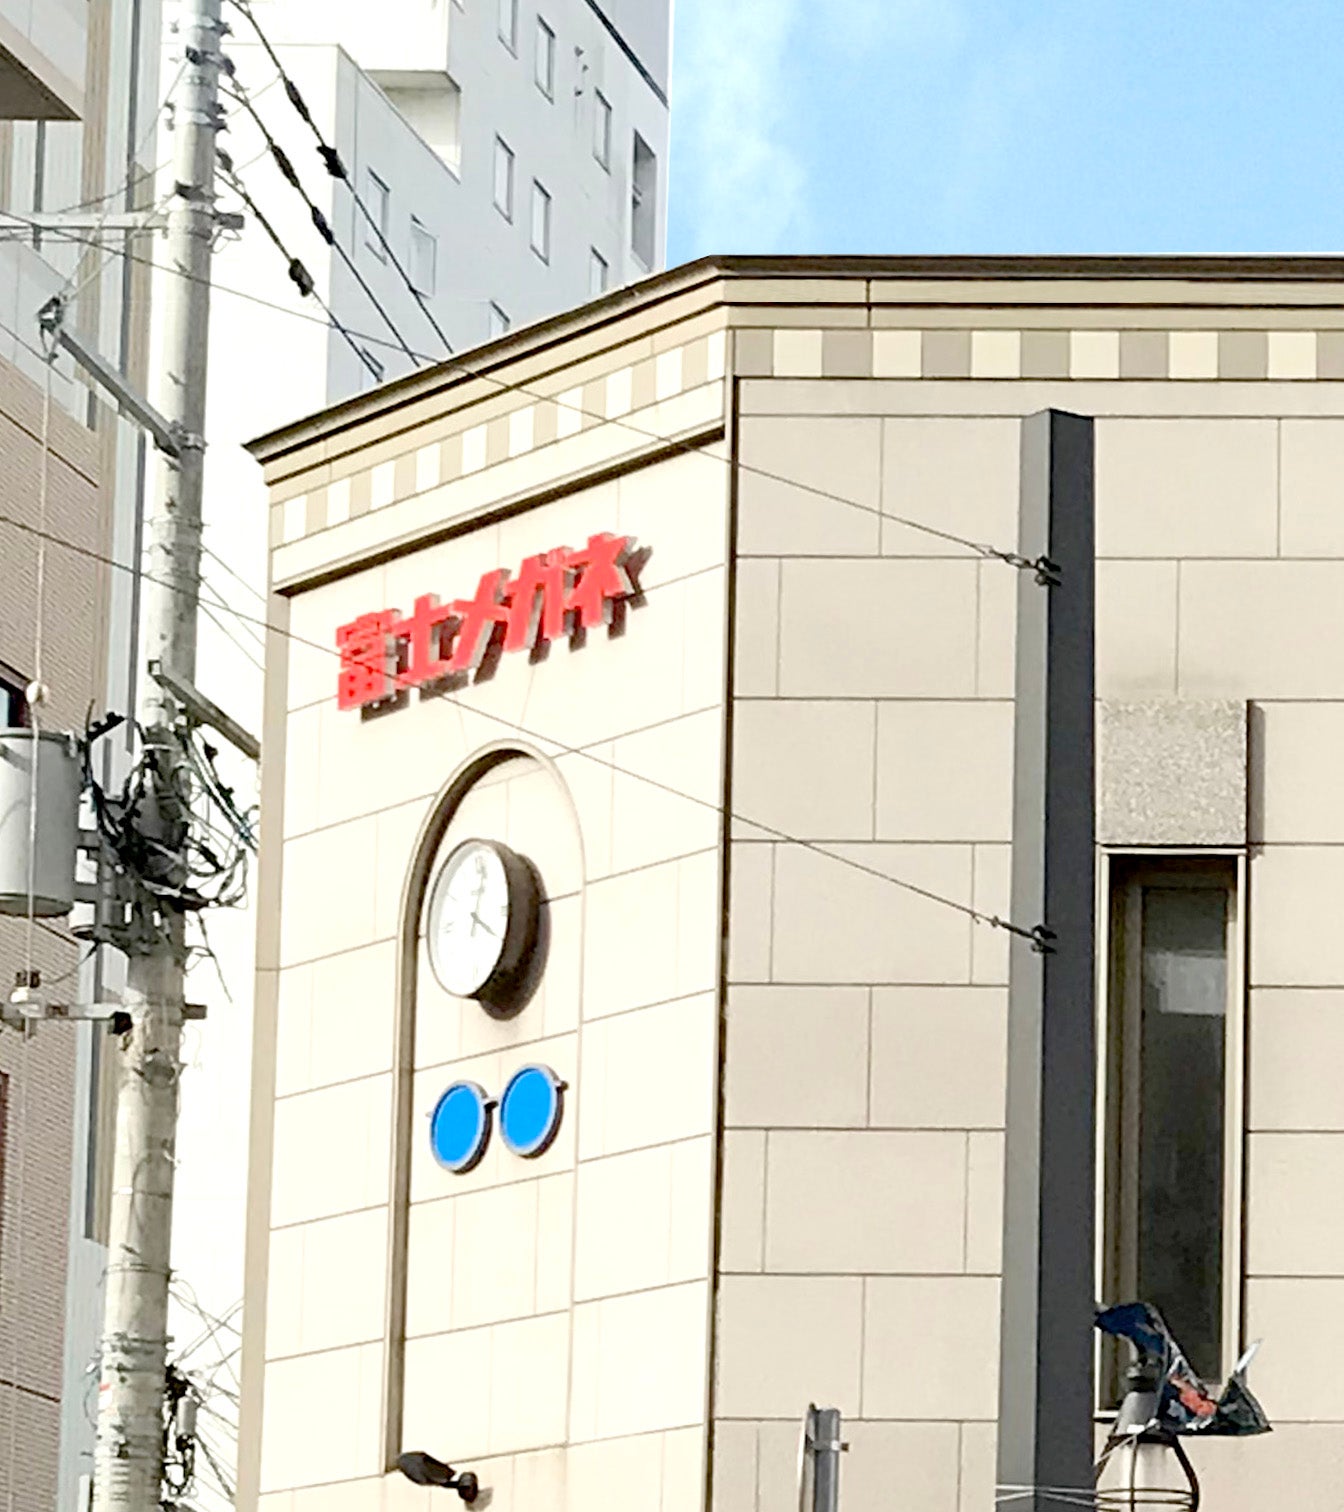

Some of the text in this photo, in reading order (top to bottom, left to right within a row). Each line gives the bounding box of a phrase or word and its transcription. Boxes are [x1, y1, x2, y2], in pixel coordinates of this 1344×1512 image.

[336, 531, 632, 712] 富士メガネ
